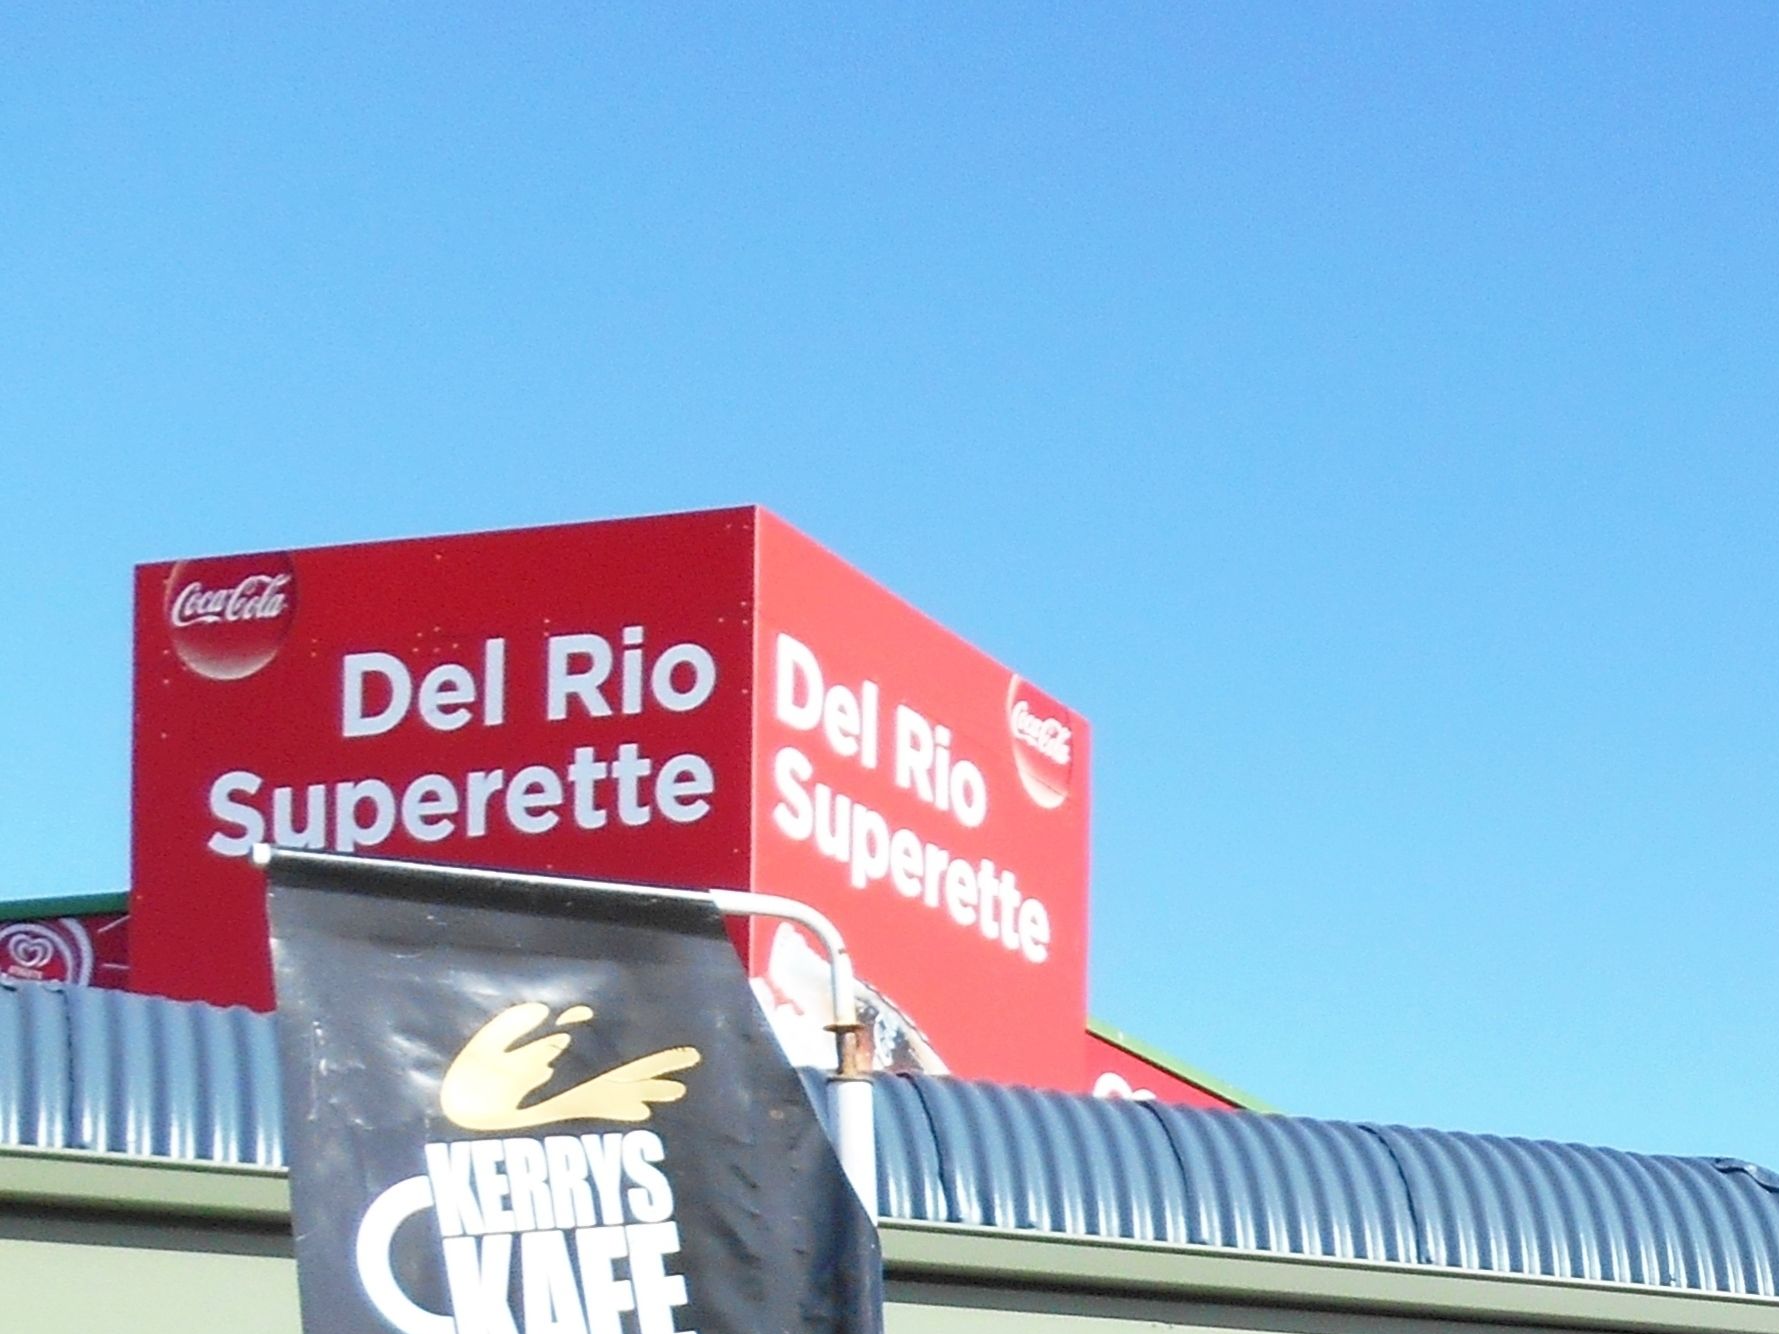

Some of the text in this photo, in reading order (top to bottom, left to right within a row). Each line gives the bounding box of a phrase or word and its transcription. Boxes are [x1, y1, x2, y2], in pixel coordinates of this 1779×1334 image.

[171, 573, 291, 628] Coca-Cola
[341, 625, 716, 738] Del Rio
[773, 632, 987, 829] Del Rio
[207, 742, 715, 857] Superette
[773, 746, 1051, 965] Superette
[425, 1130, 675, 1237] KERRYS
